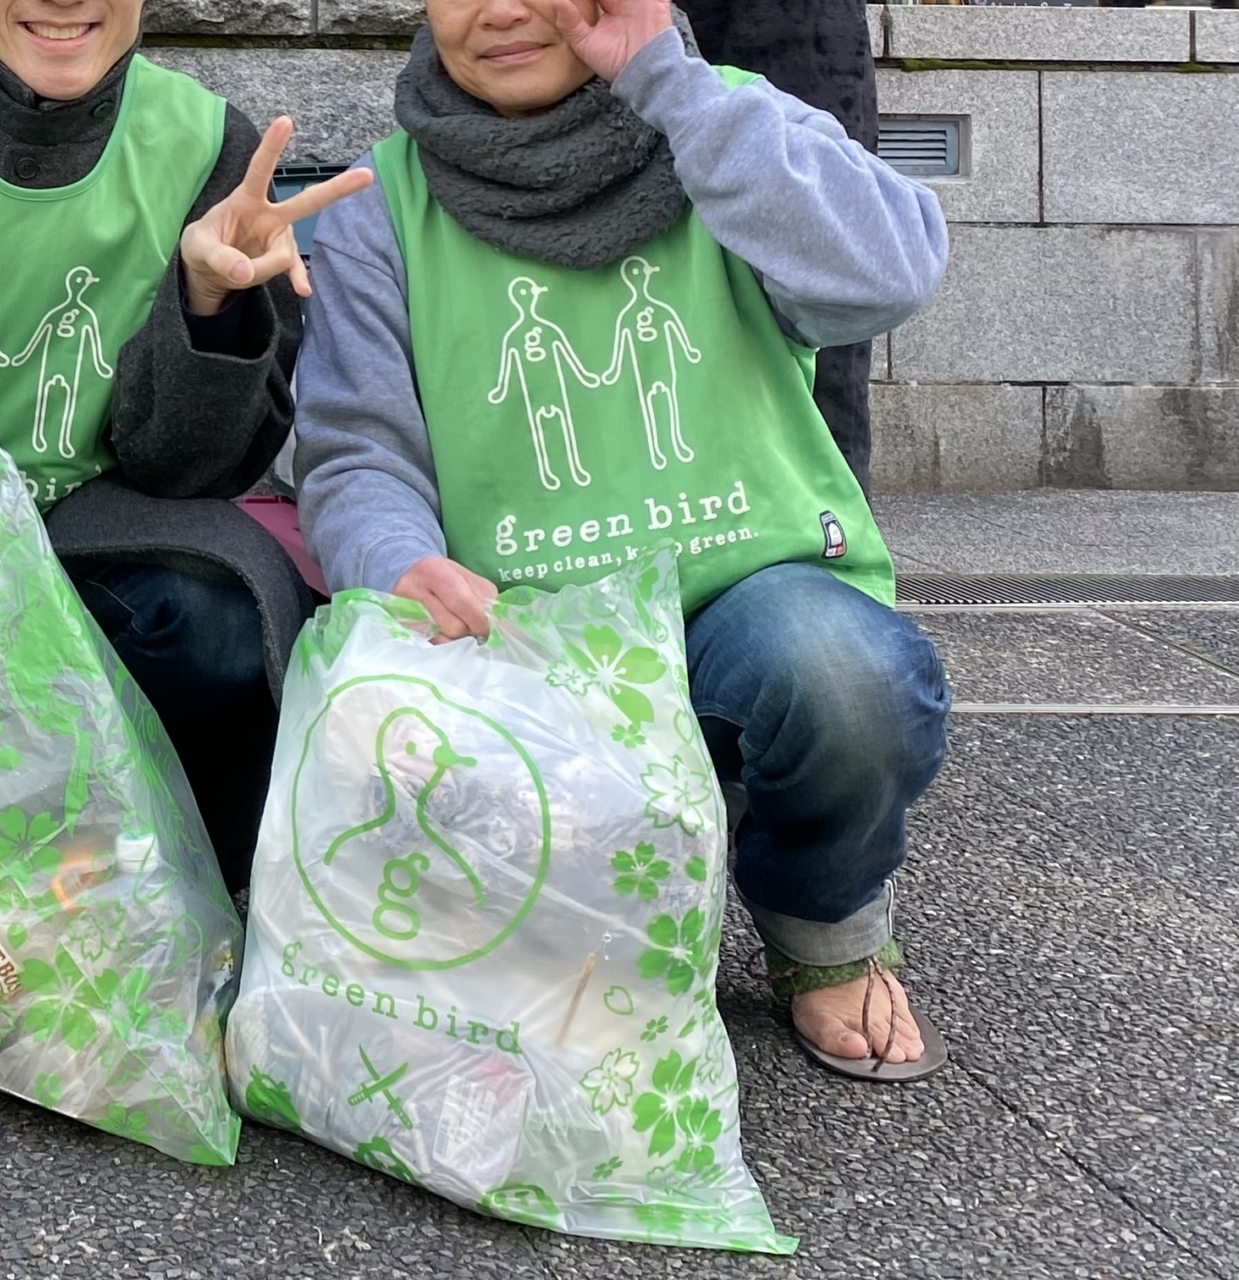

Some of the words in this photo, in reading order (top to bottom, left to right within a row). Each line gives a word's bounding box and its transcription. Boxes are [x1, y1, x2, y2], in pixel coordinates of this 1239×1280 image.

[56, 308, 80, 338] g
[524, 326, 547, 362] g
[636, 305, 658, 341] g
[495, 514, 633, 556] green
[644, 481, 751, 531] bird
[498, 562, 548, 582] keep
[553, 549, 623, 572] clean,
[625, 542, 682, 560] kp
[690, 527, 759, 554] green.
[372, 852, 430, 941] g
[279, 940, 412, 1020] green
[413, 995, 523, 1055] bird
